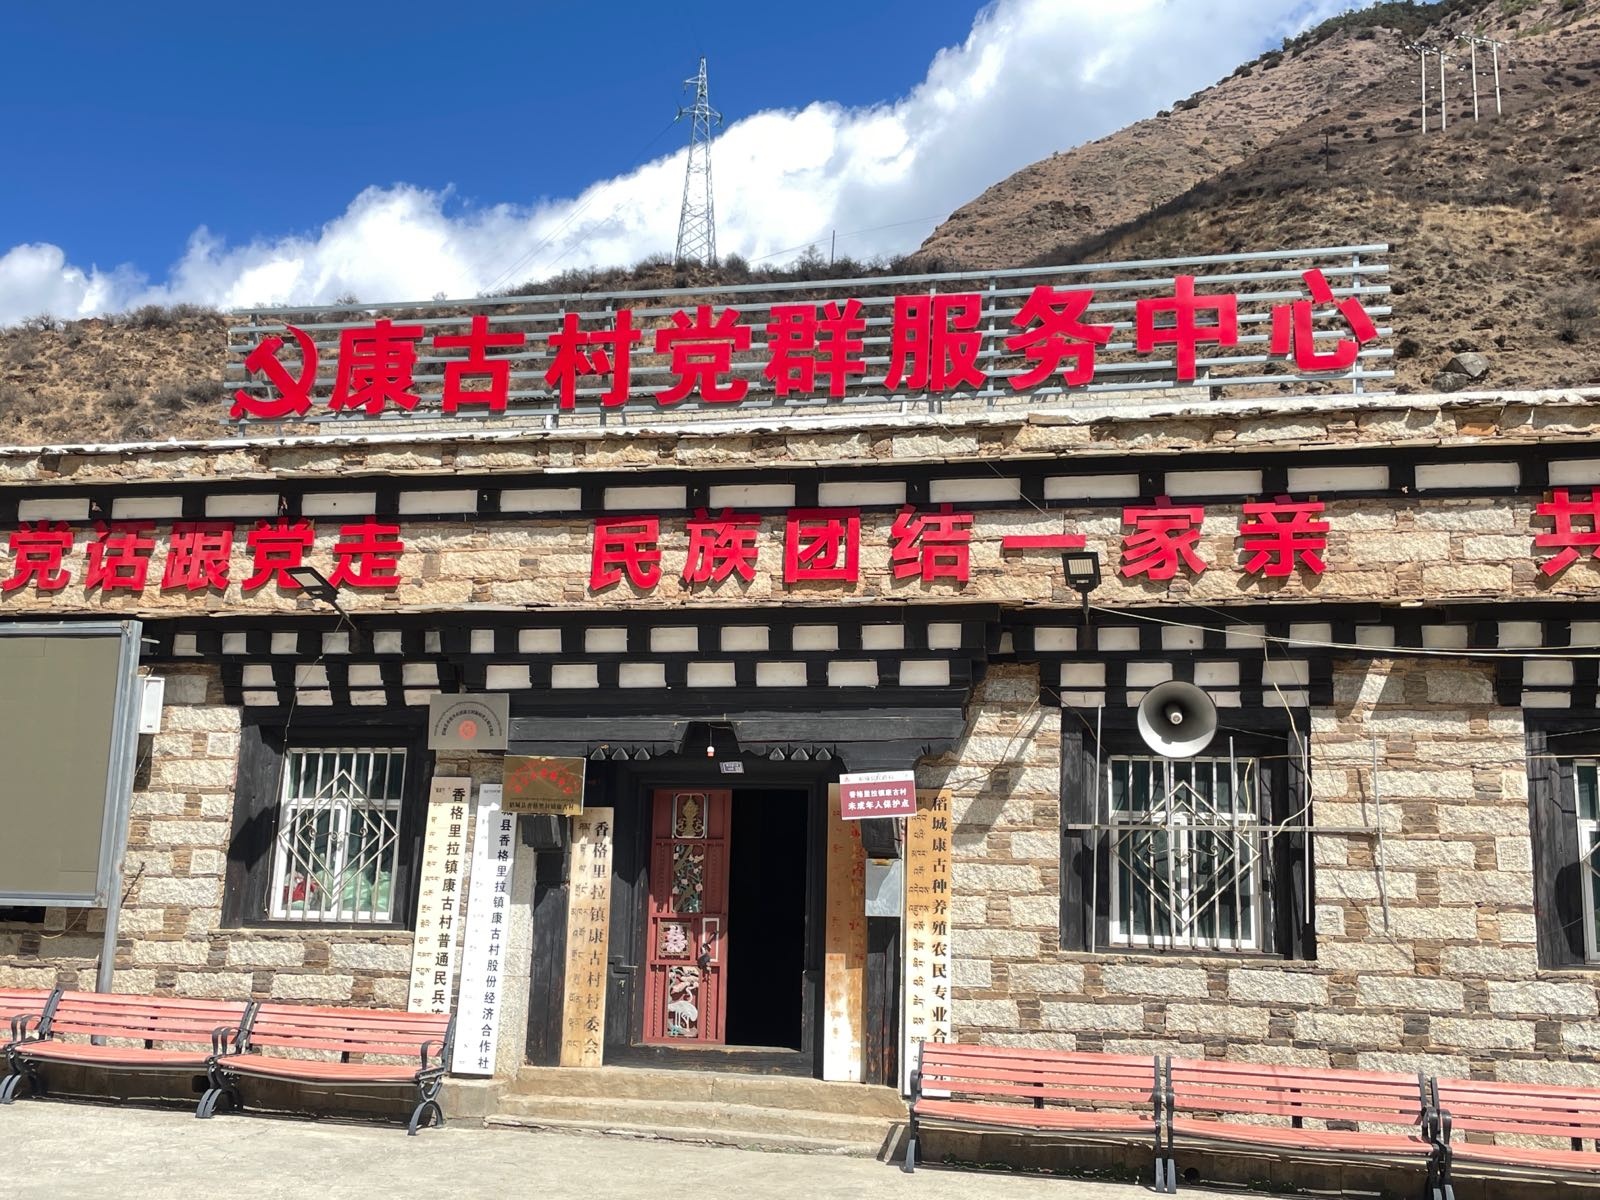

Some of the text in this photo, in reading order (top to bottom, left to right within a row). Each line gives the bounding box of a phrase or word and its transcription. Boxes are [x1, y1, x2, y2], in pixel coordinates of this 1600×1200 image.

[328, 269, 1378, 415] 康古村党群服务中心
[1, 516, 404, 592] 党话跟党走
[590, 494, 1330, 591] 民族团结一家亲
[1535, 488, 1600, 577] 共
[848, 799, 910, 811] 未成年人保护点
[583, 821, 609, 1055] 香格里拉镇康古村村委会
[931, 796, 948, 1082] 稻城康古种养殖农民专业合
